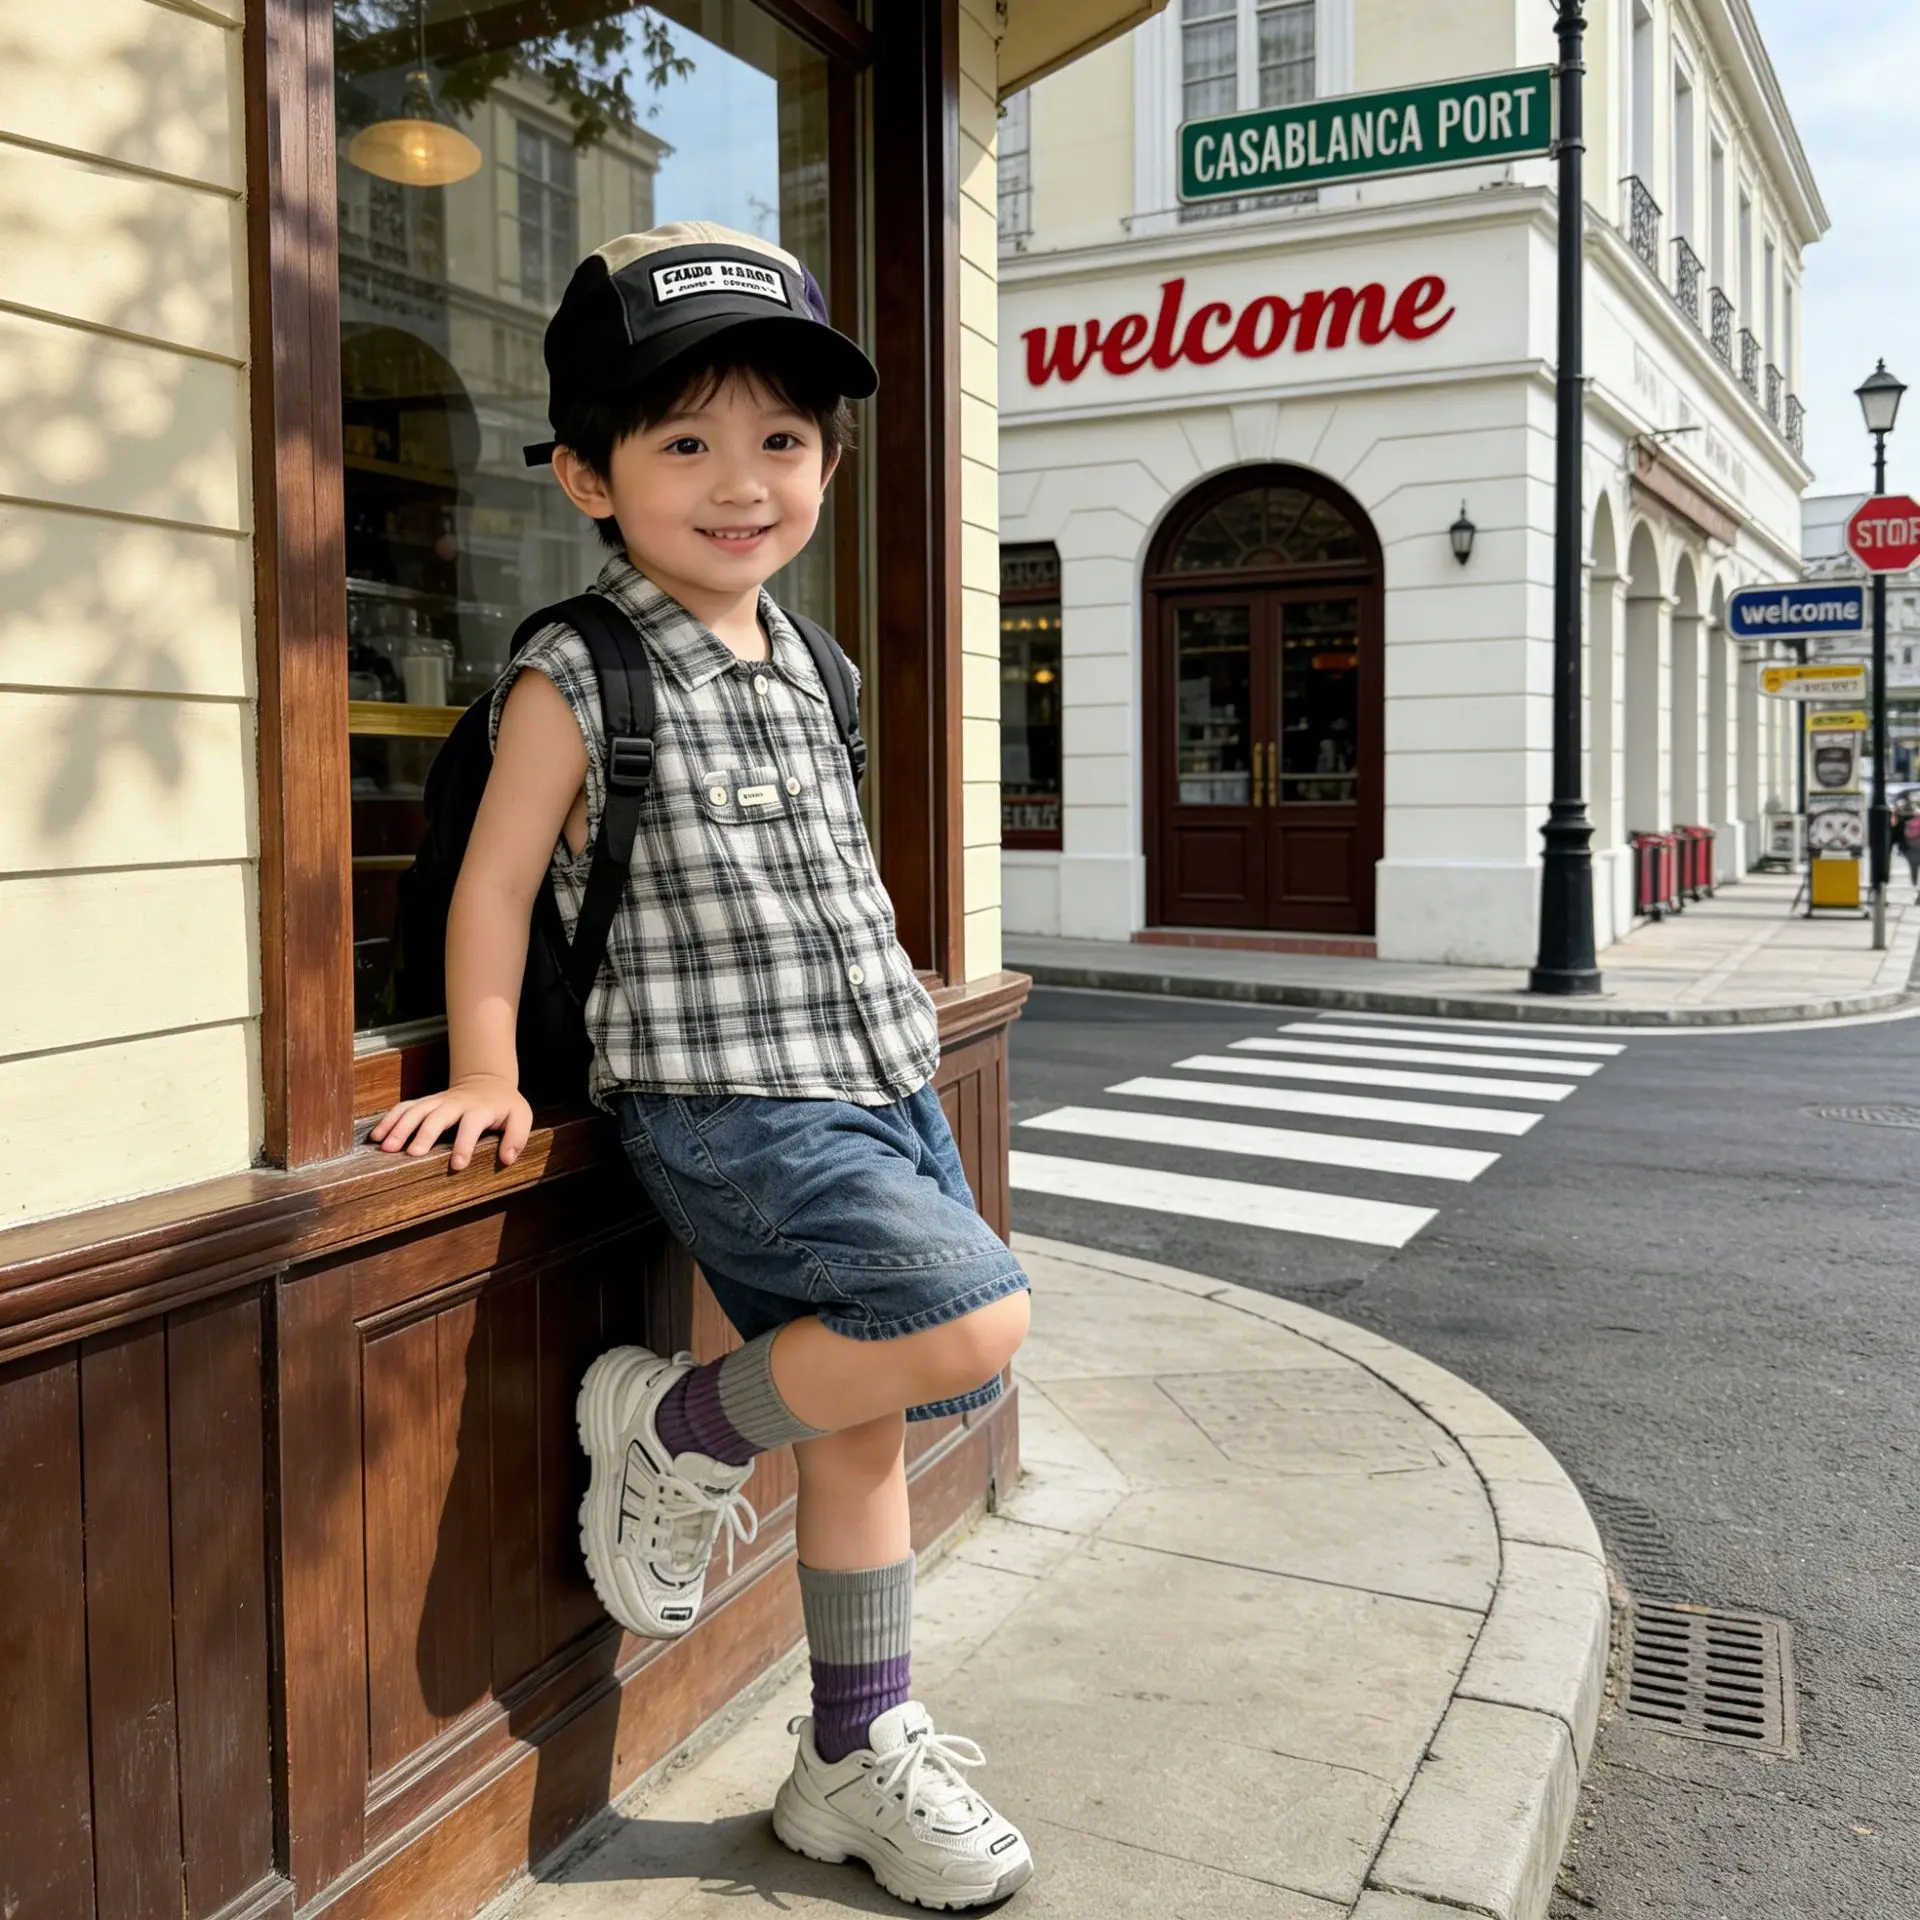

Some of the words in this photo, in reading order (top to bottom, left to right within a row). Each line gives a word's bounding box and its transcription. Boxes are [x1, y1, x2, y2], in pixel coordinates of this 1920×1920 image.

[1194, 105, 1422, 182] CASABLANCA
[1438, 87, 1536, 148] PORT
[1021, 275, 1456, 386] welcome
[1741, 596, 1859, 625] welcome
